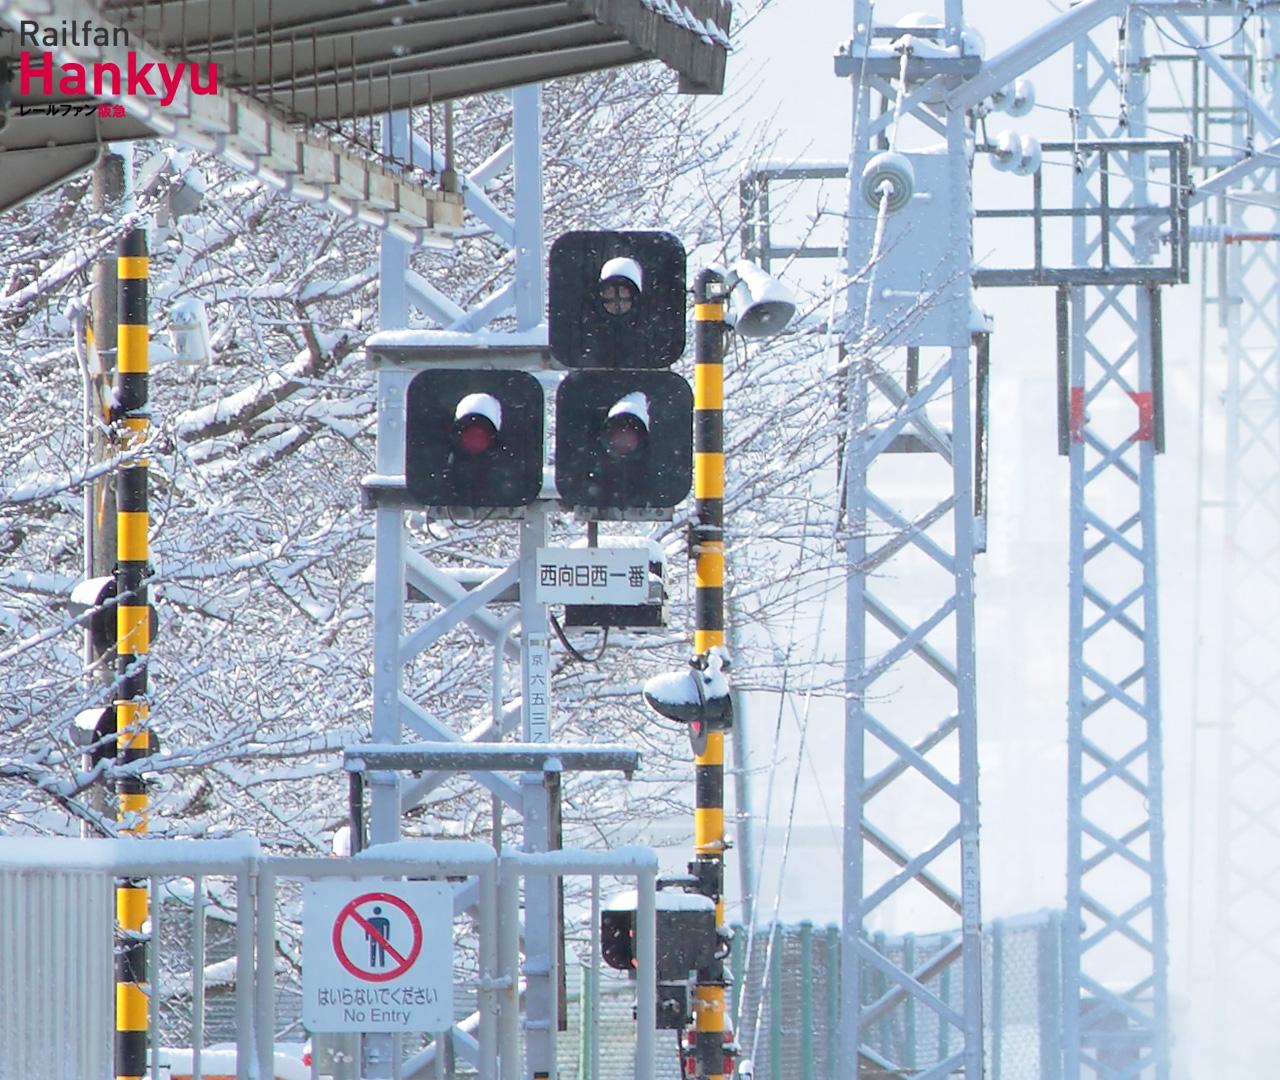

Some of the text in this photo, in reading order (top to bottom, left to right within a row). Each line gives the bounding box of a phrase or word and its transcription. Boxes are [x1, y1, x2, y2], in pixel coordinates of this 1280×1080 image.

[540, 564, 645, 588] 西向日西一番
[317, 987, 438, 1006] はいらないでください
[344, 1009, 411, 1025] No Entry
